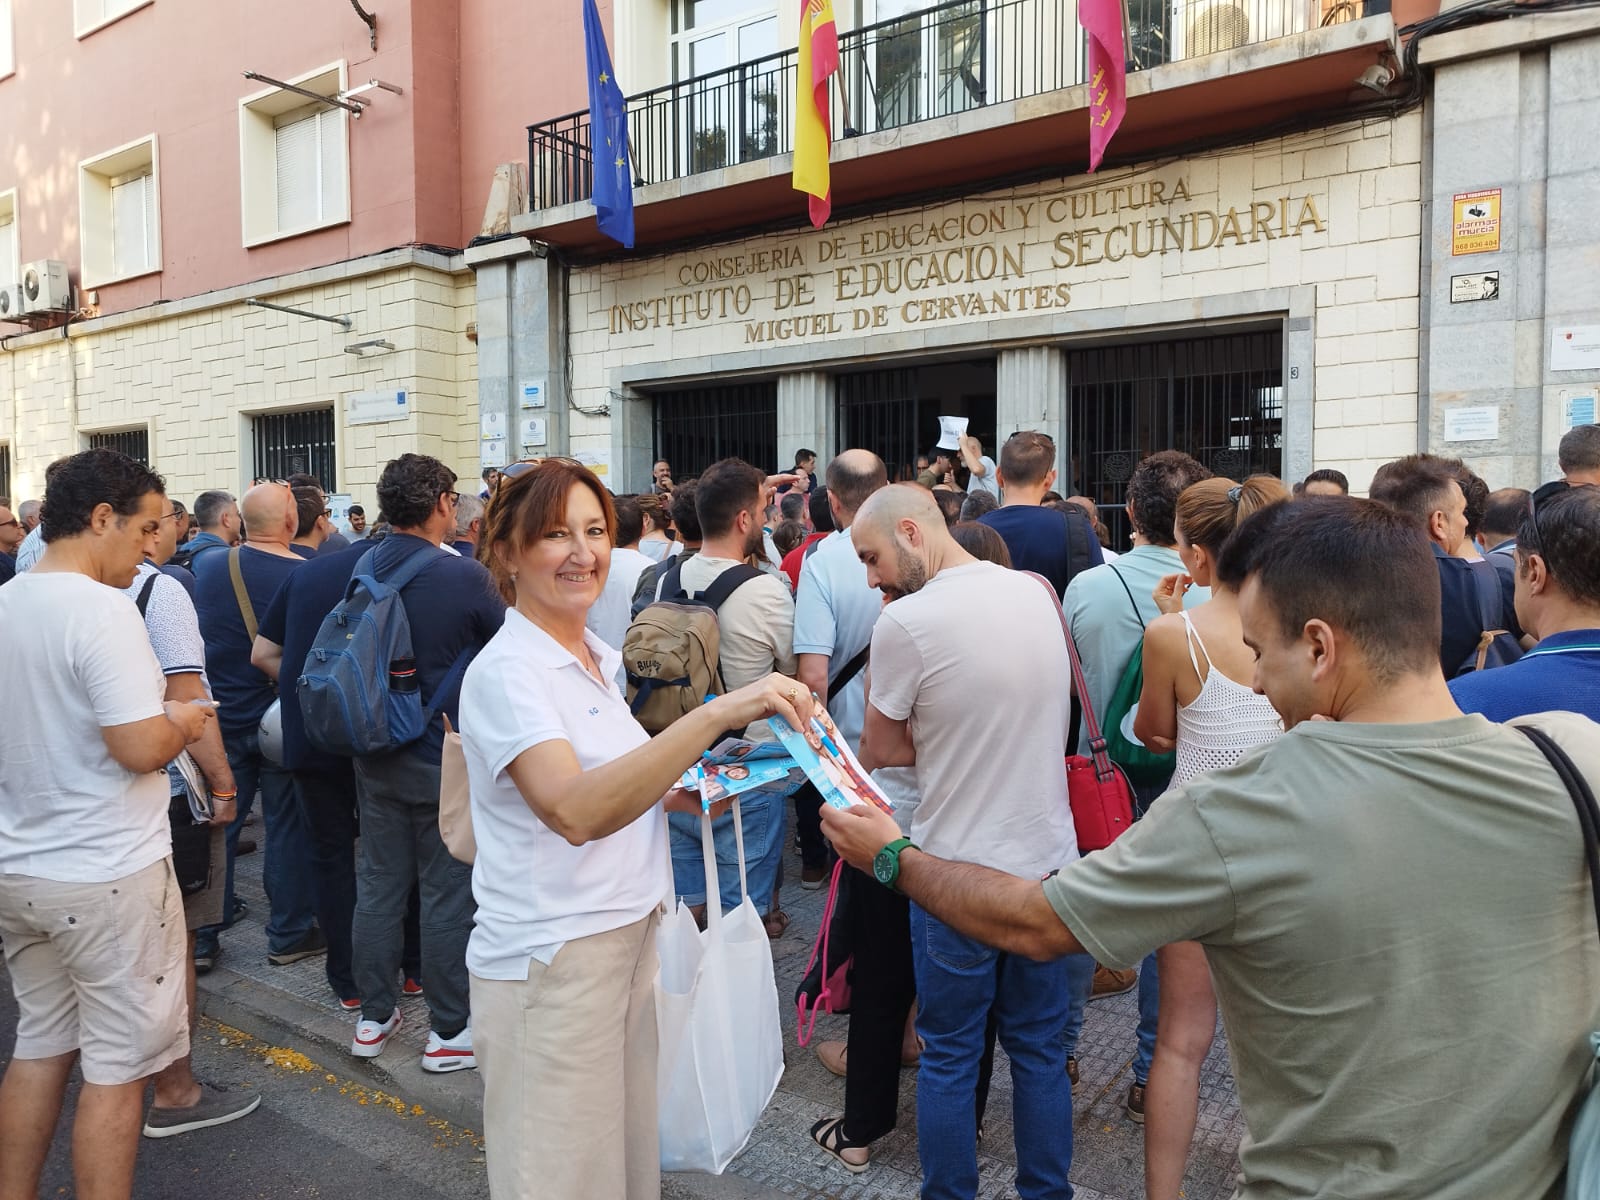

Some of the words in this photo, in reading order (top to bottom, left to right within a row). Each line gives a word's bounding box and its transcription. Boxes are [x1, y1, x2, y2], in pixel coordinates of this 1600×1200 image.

[678, 245, 804, 286] CONSEJERIA
[818, 237, 847, 263] DE
[860, 206, 1006, 256] EDUCACION
[1016, 202, 1035, 229] Y
[1046, 177, 1192, 223] CULTURA
[1455, 219, 1498, 230] alarmas
[1458, 226, 1495, 236] murcia
[608, 284, 752, 334] INSTITUTO
[774, 272, 816, 310] DE
[835, 242, 1026, 301] EDUCACION
[1051, 193, 1327, 269] SECUNDARIA
[744, 313, 842, 344] MIGUEL
[852, 305, 888, 331] DE
[900, 282, 1072, 324] CERVANTES
[1291, 367, 1298, 379] 3
